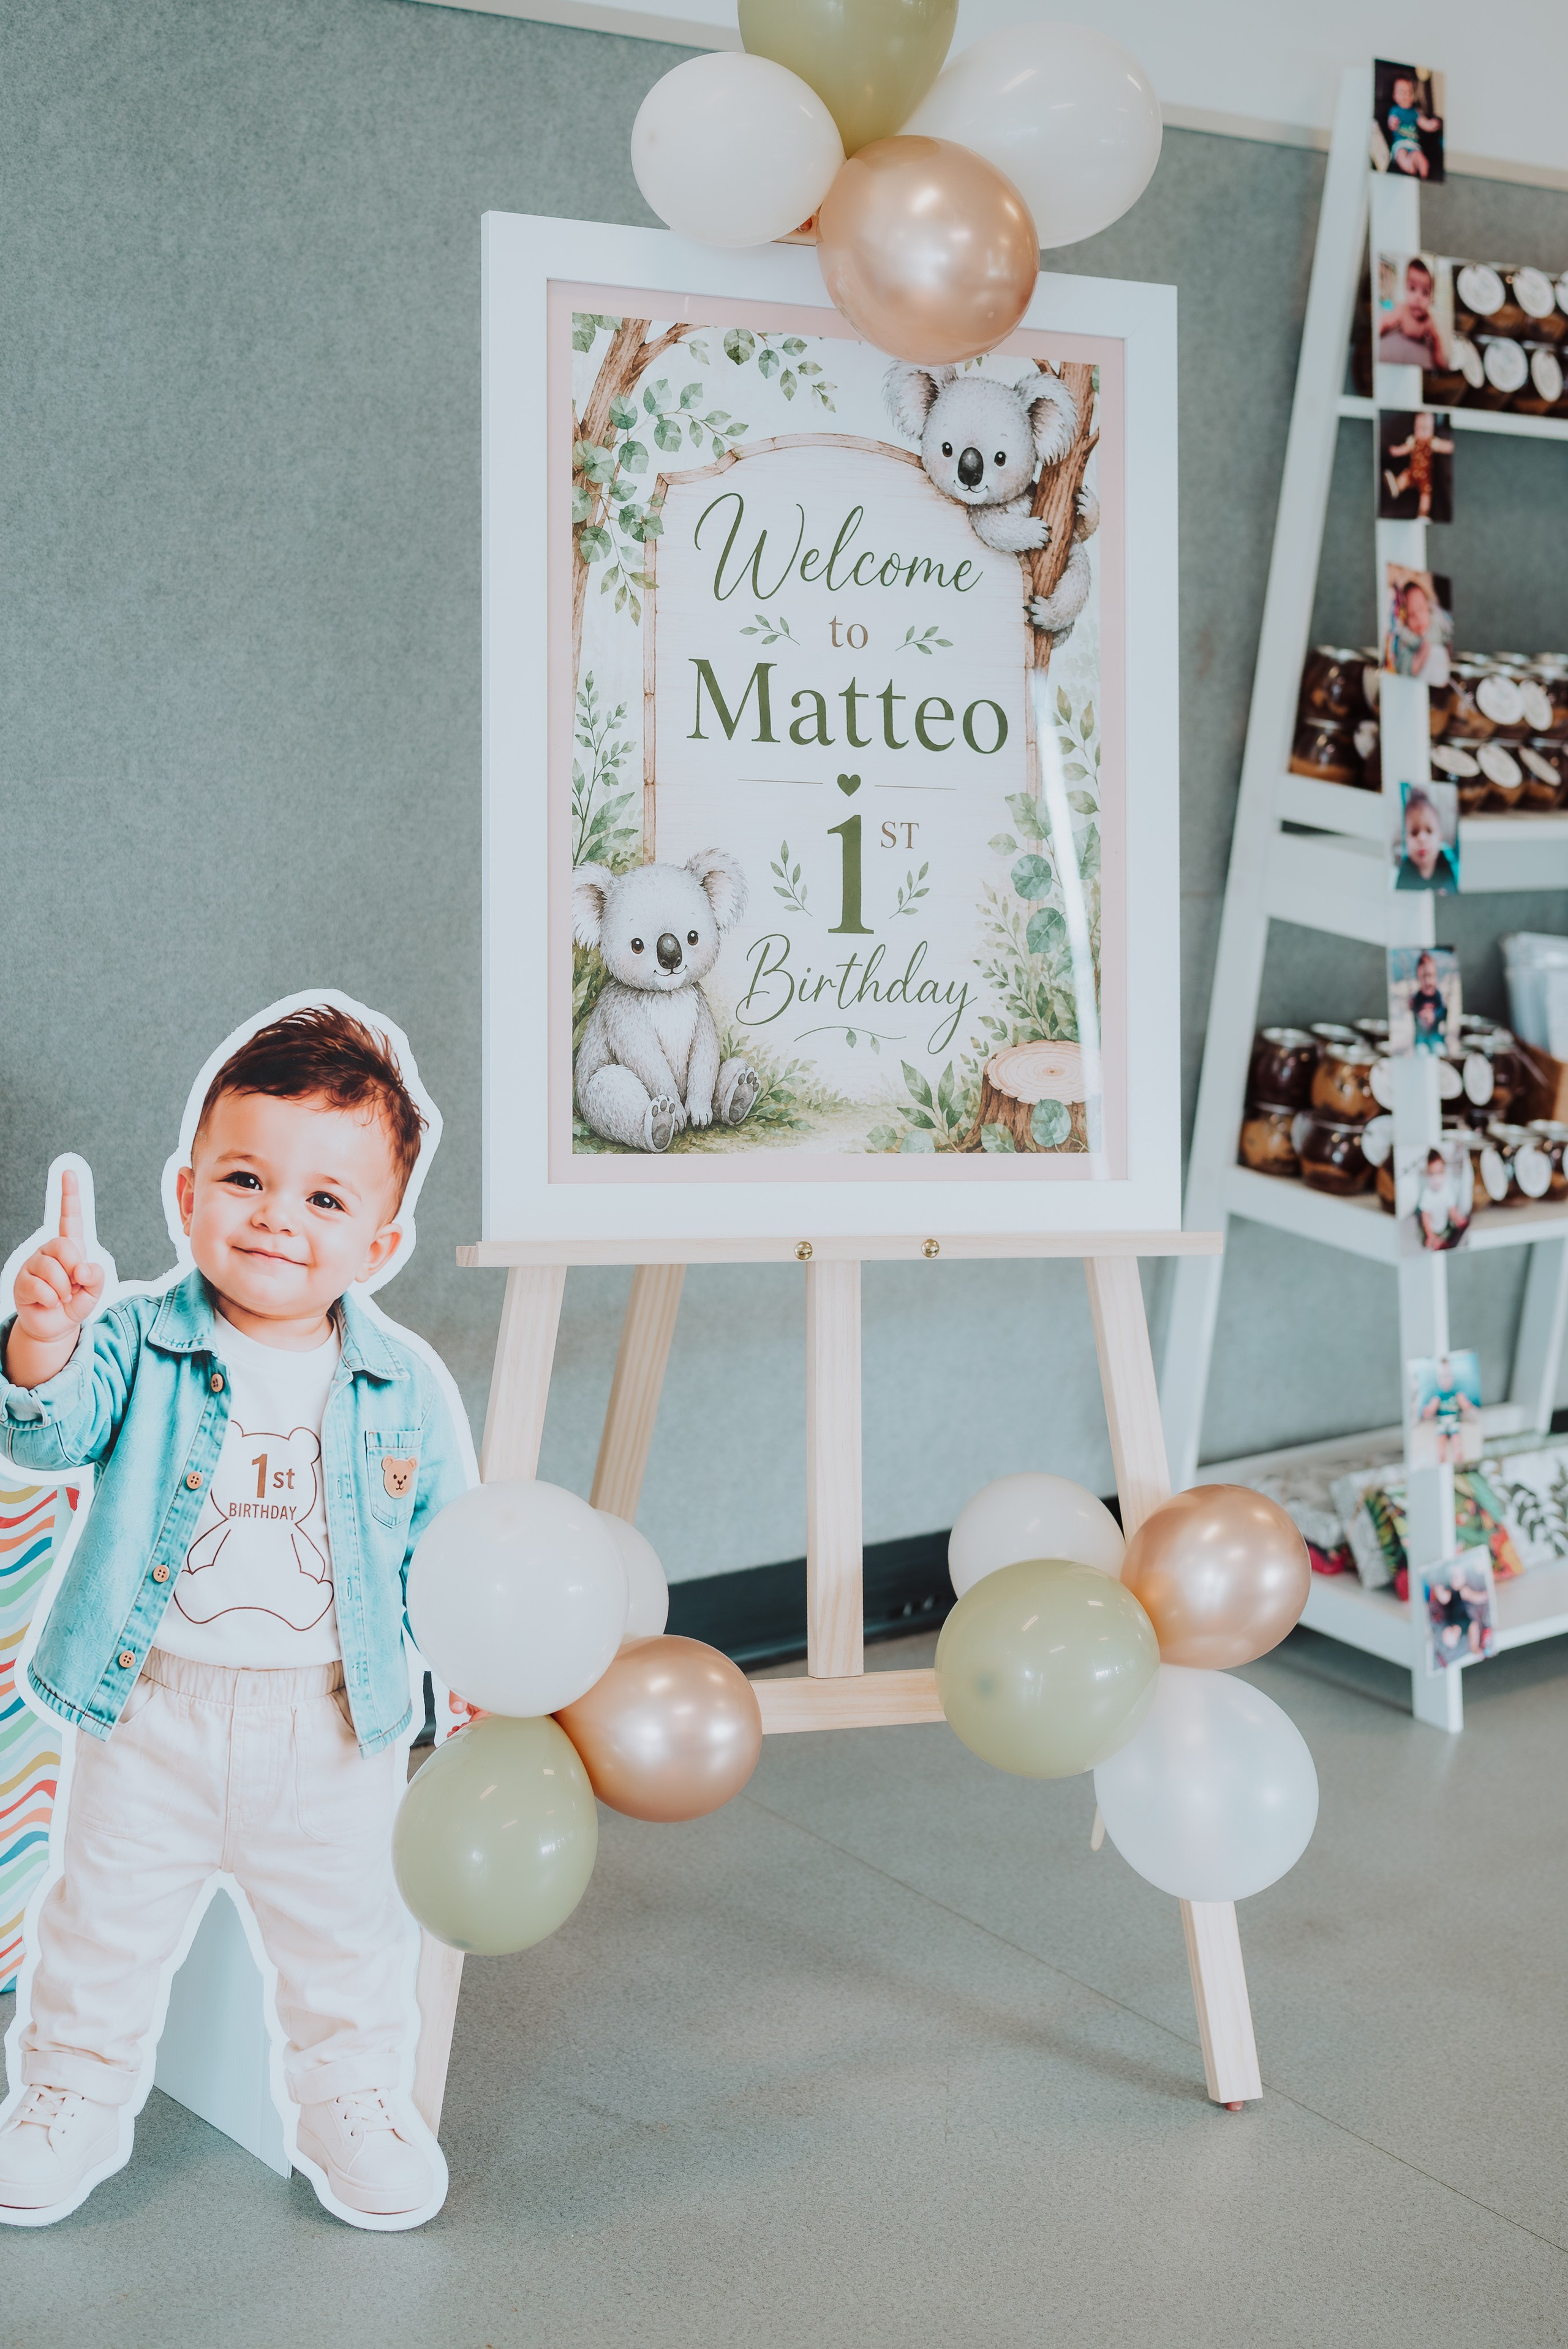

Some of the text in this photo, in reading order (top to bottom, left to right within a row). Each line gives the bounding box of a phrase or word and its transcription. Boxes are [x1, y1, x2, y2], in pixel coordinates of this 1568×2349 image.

[694, 492, 983, 601] Welcome
[828, 614, 869, 649] to
[686, 658, 1008, 755] Matteo
[735, 933, 978, 1055] Birthday
[252, 1454, 295, 1498] 1st
[228, 1502, 297, 1521] BIRTHDAY
